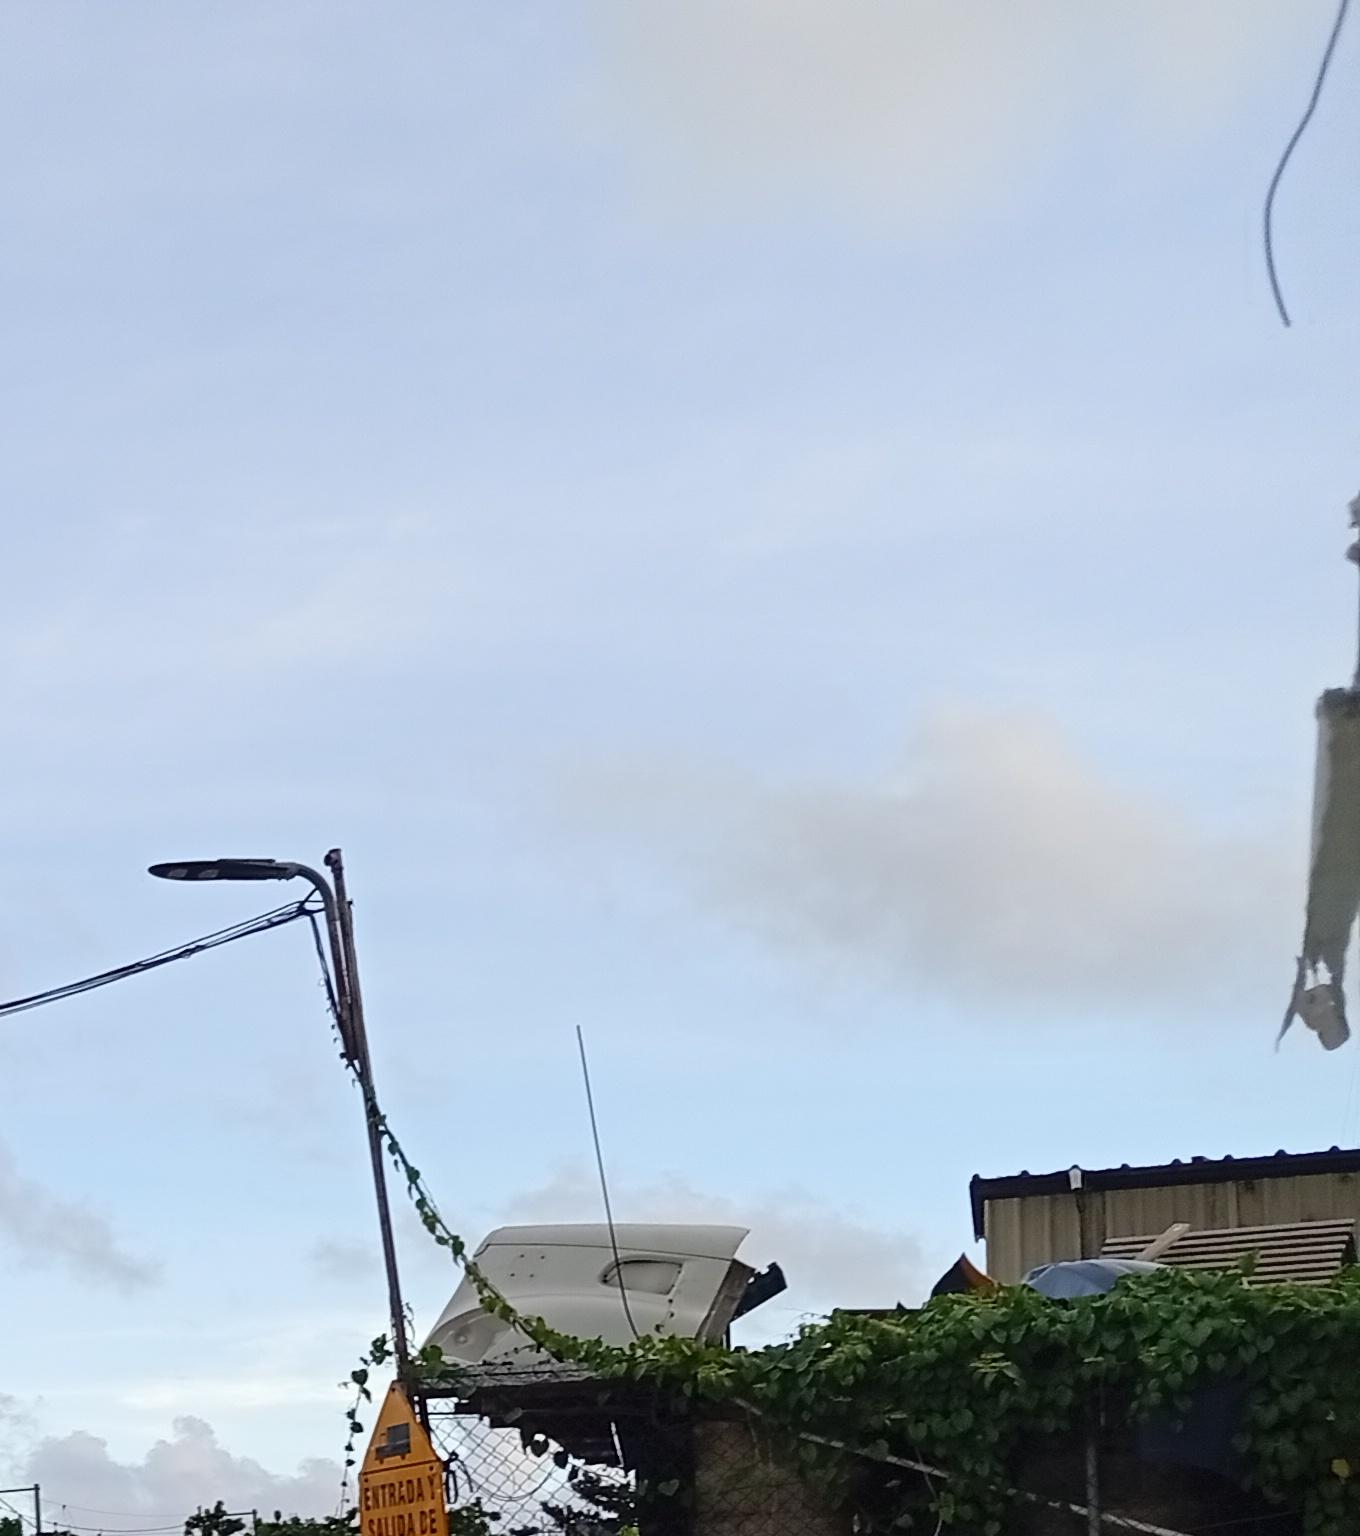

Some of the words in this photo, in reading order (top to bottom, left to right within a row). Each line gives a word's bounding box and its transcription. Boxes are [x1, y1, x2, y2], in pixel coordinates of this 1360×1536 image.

[364, 1478, 425, 1511] ENTRADA
[427, 1475, 436, 1500] Y
[419, 1509, 437, 1536] DE
